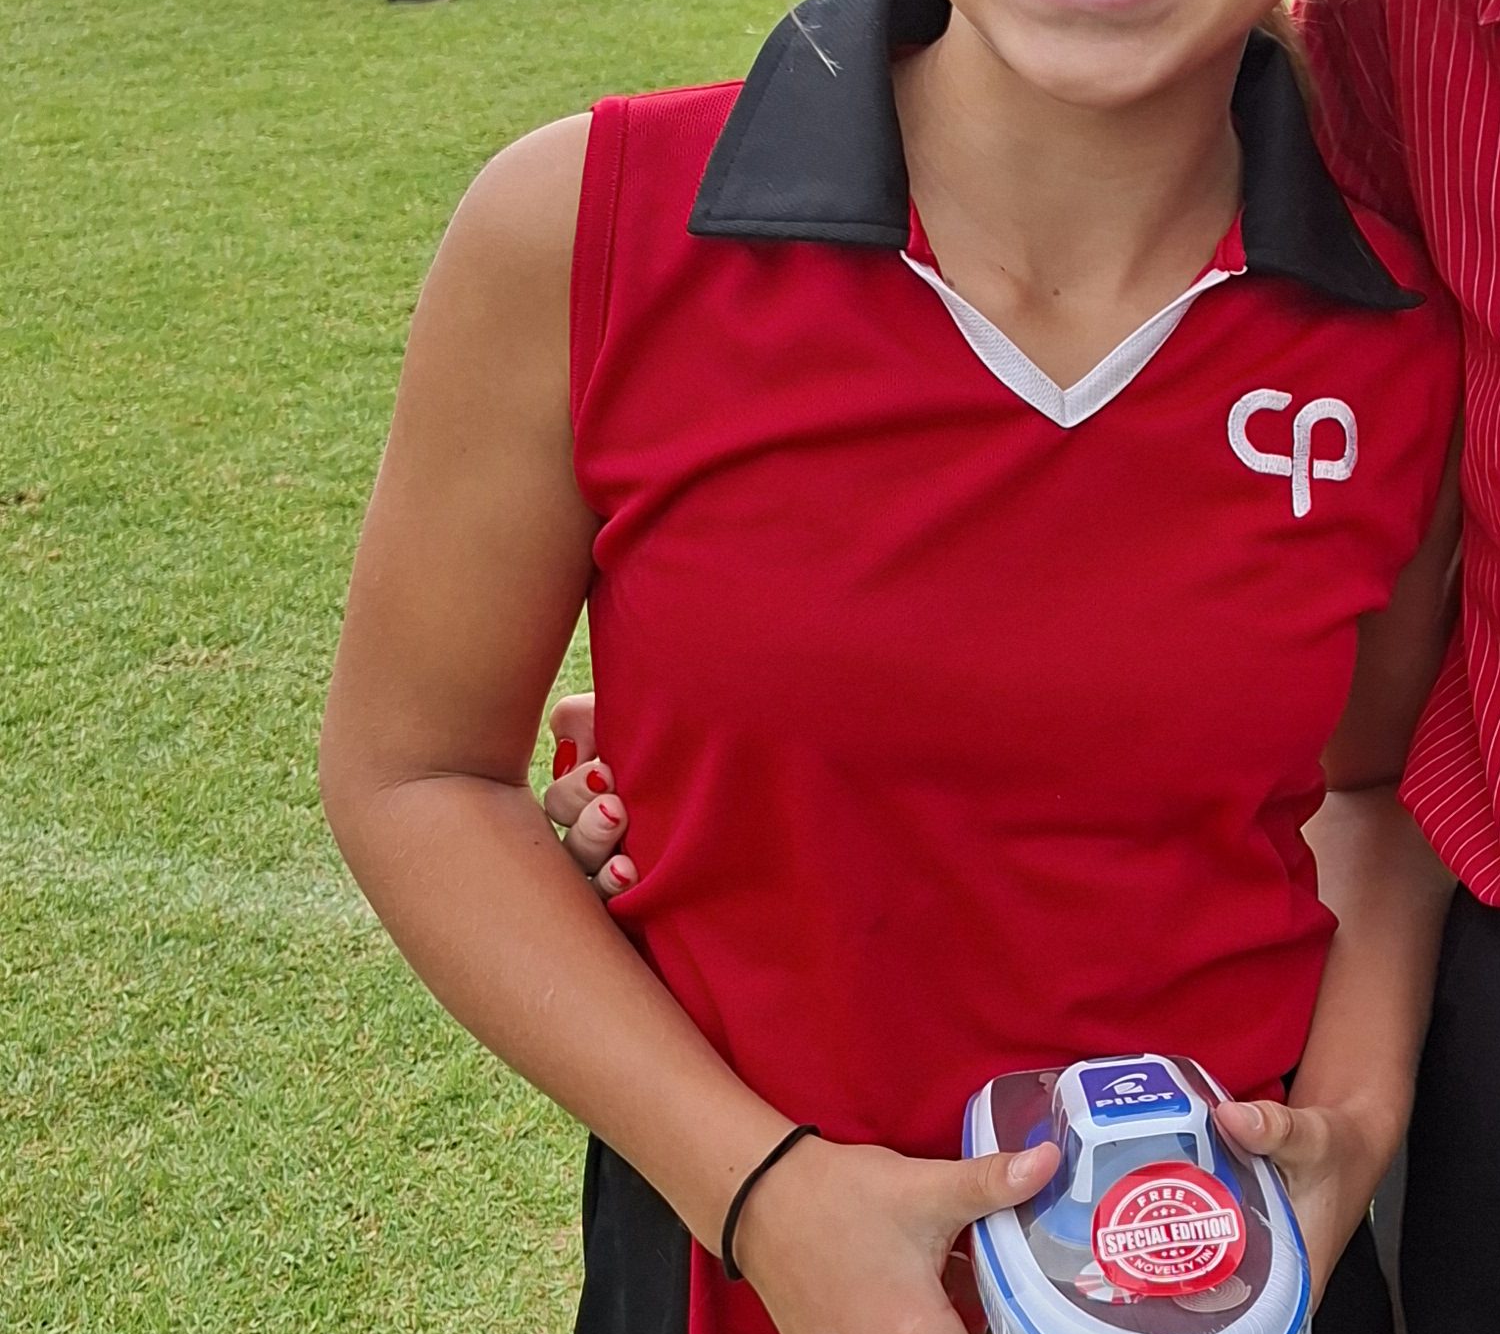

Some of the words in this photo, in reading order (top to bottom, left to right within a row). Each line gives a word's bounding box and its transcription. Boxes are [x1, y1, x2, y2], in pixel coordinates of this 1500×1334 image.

[1095, 1092, 1175, 1108] PILOT
[1136, 1188, 1186, 1208] FREE
[1105, 1225, 1170, 1254] SPECIAL
[1170, 1215, 1233, 1246] EDITION
[1133, 1258, 1196, 1275] NOVELTY
[1194, 1248, 1215, 1266] TIN
